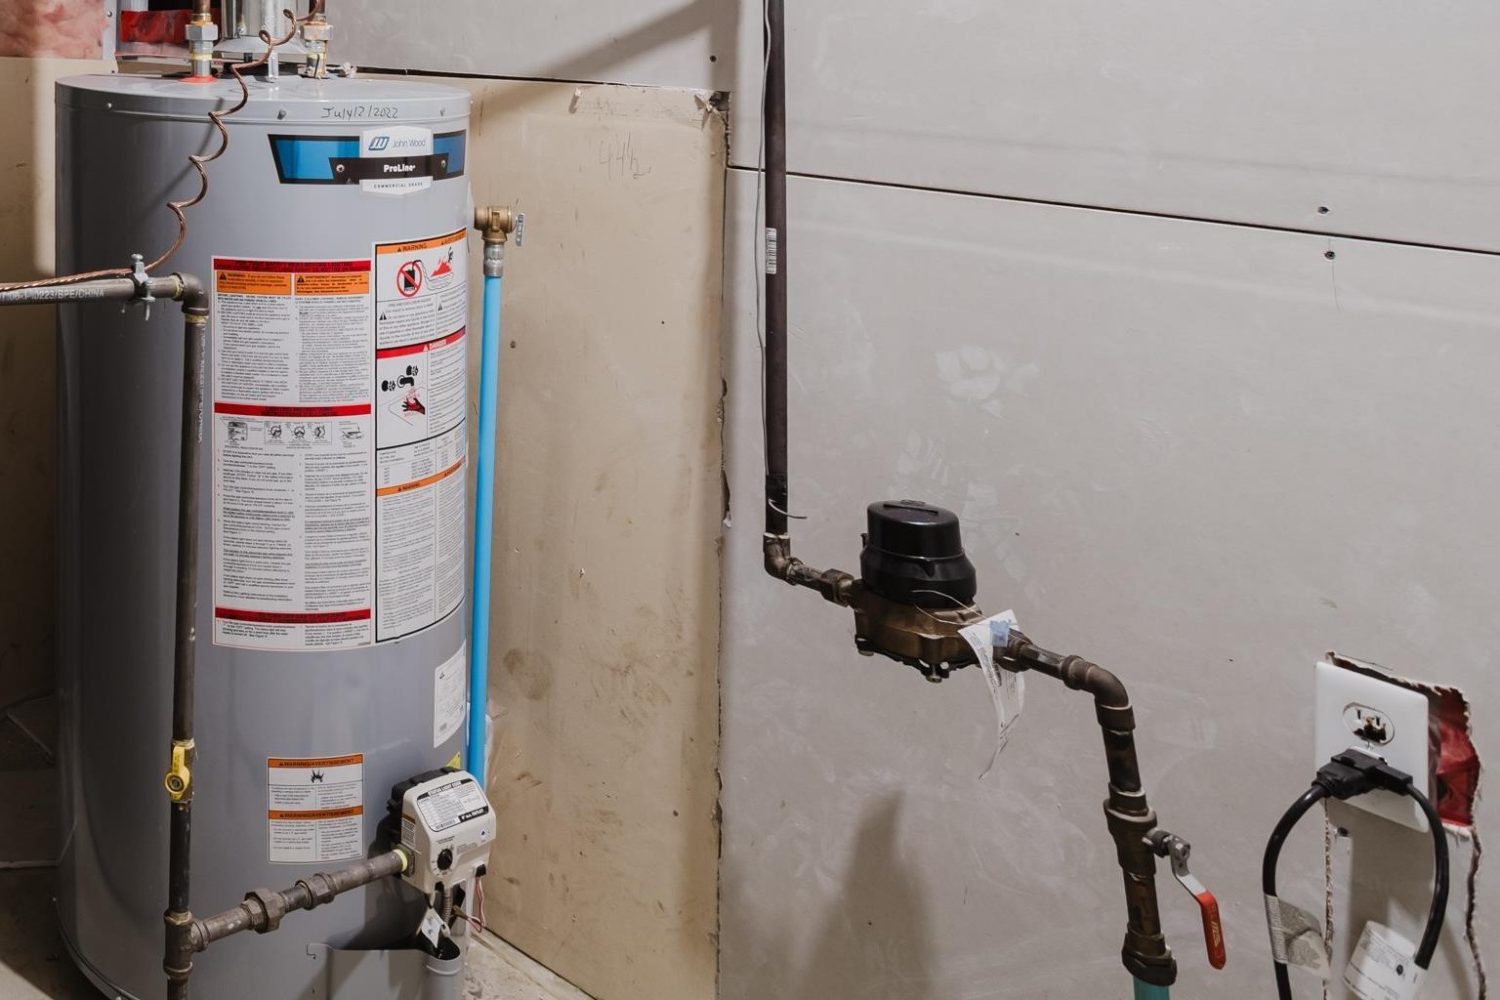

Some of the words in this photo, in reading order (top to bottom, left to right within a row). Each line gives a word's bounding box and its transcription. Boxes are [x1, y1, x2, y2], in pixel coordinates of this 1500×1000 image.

[392, 138, 408, 148] John
[409, 138, 427, 148] Wood
[402, 243, 428, 252] WARNING
